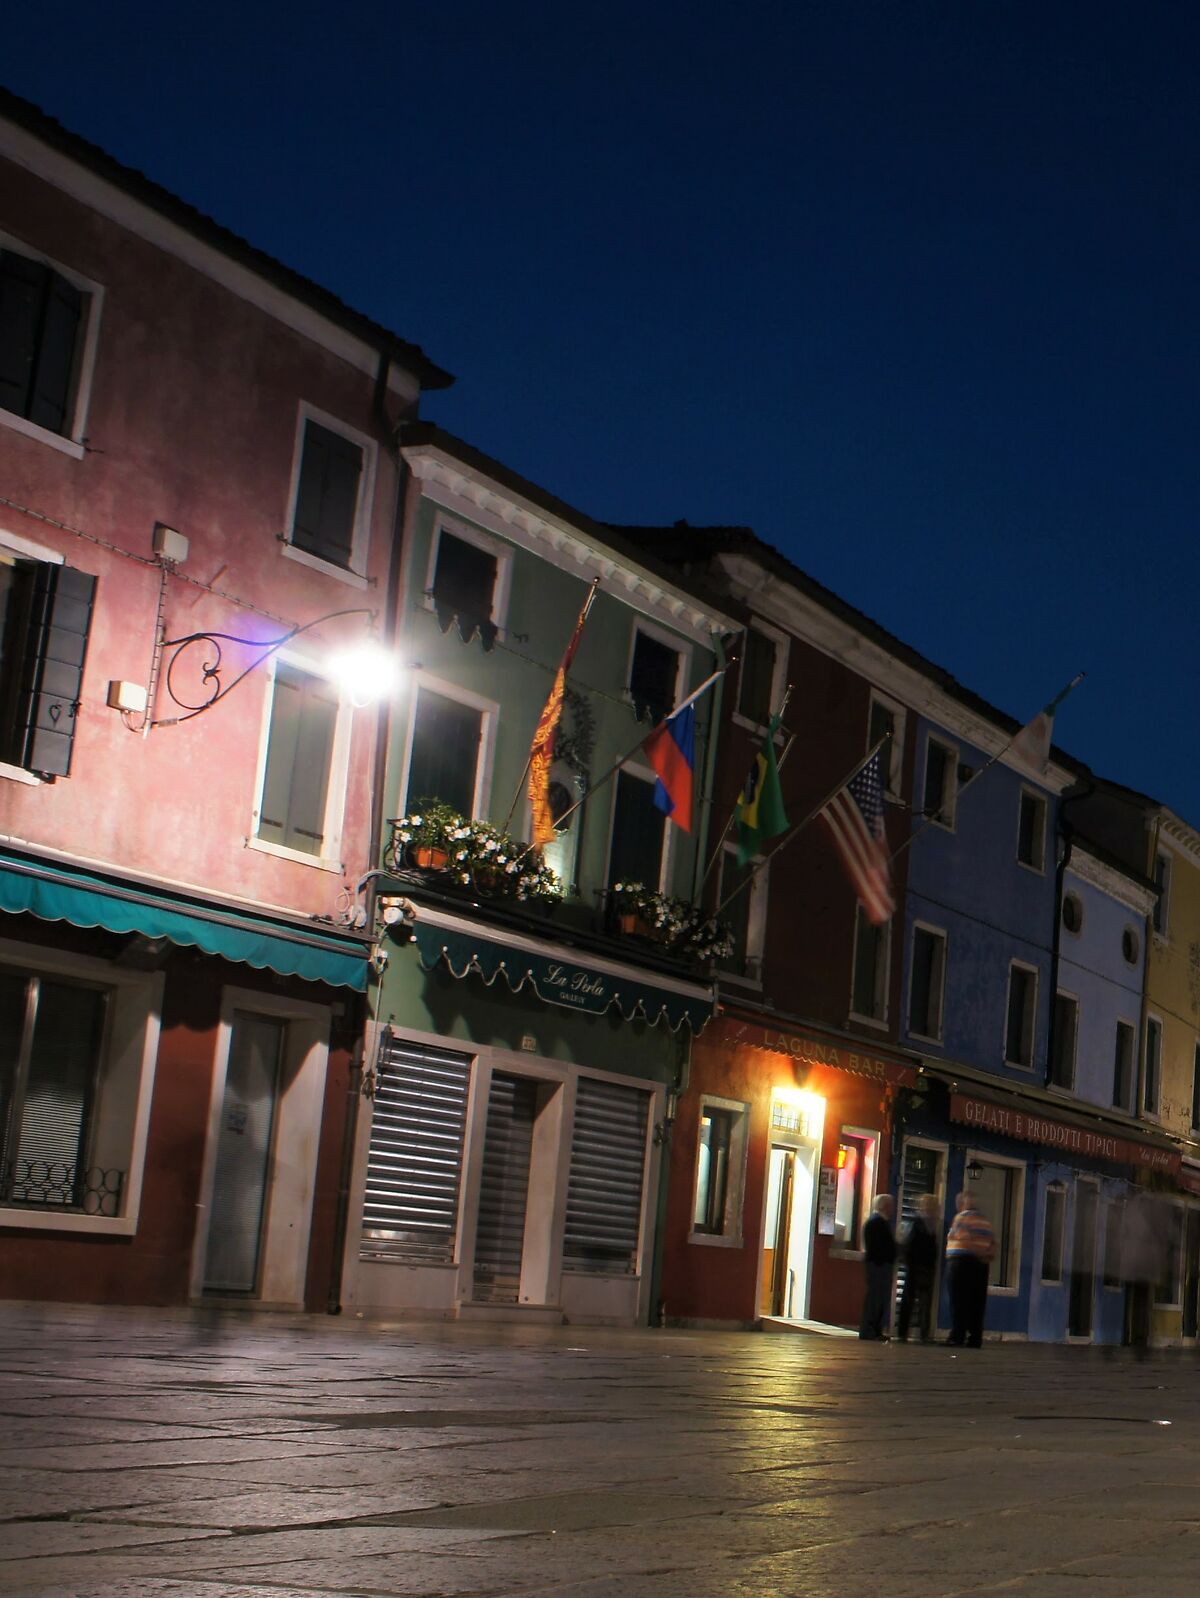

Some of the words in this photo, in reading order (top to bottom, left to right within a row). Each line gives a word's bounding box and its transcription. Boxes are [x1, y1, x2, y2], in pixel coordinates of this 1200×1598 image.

[542, 964, 567, 986] La
[571, 972, 604, 996] Perla
[763, 1030, 840, 1064] LAGUNA
[850, 1054, 886, 1076] BAR
[965, 1101, 1009, 1130] GELATI
[1015, 1115, 1023, 1134] E
[1027, 1118, 1082, 1149] PRODOTTI
[1086, 1134, 1118, 1157] TIPICI
